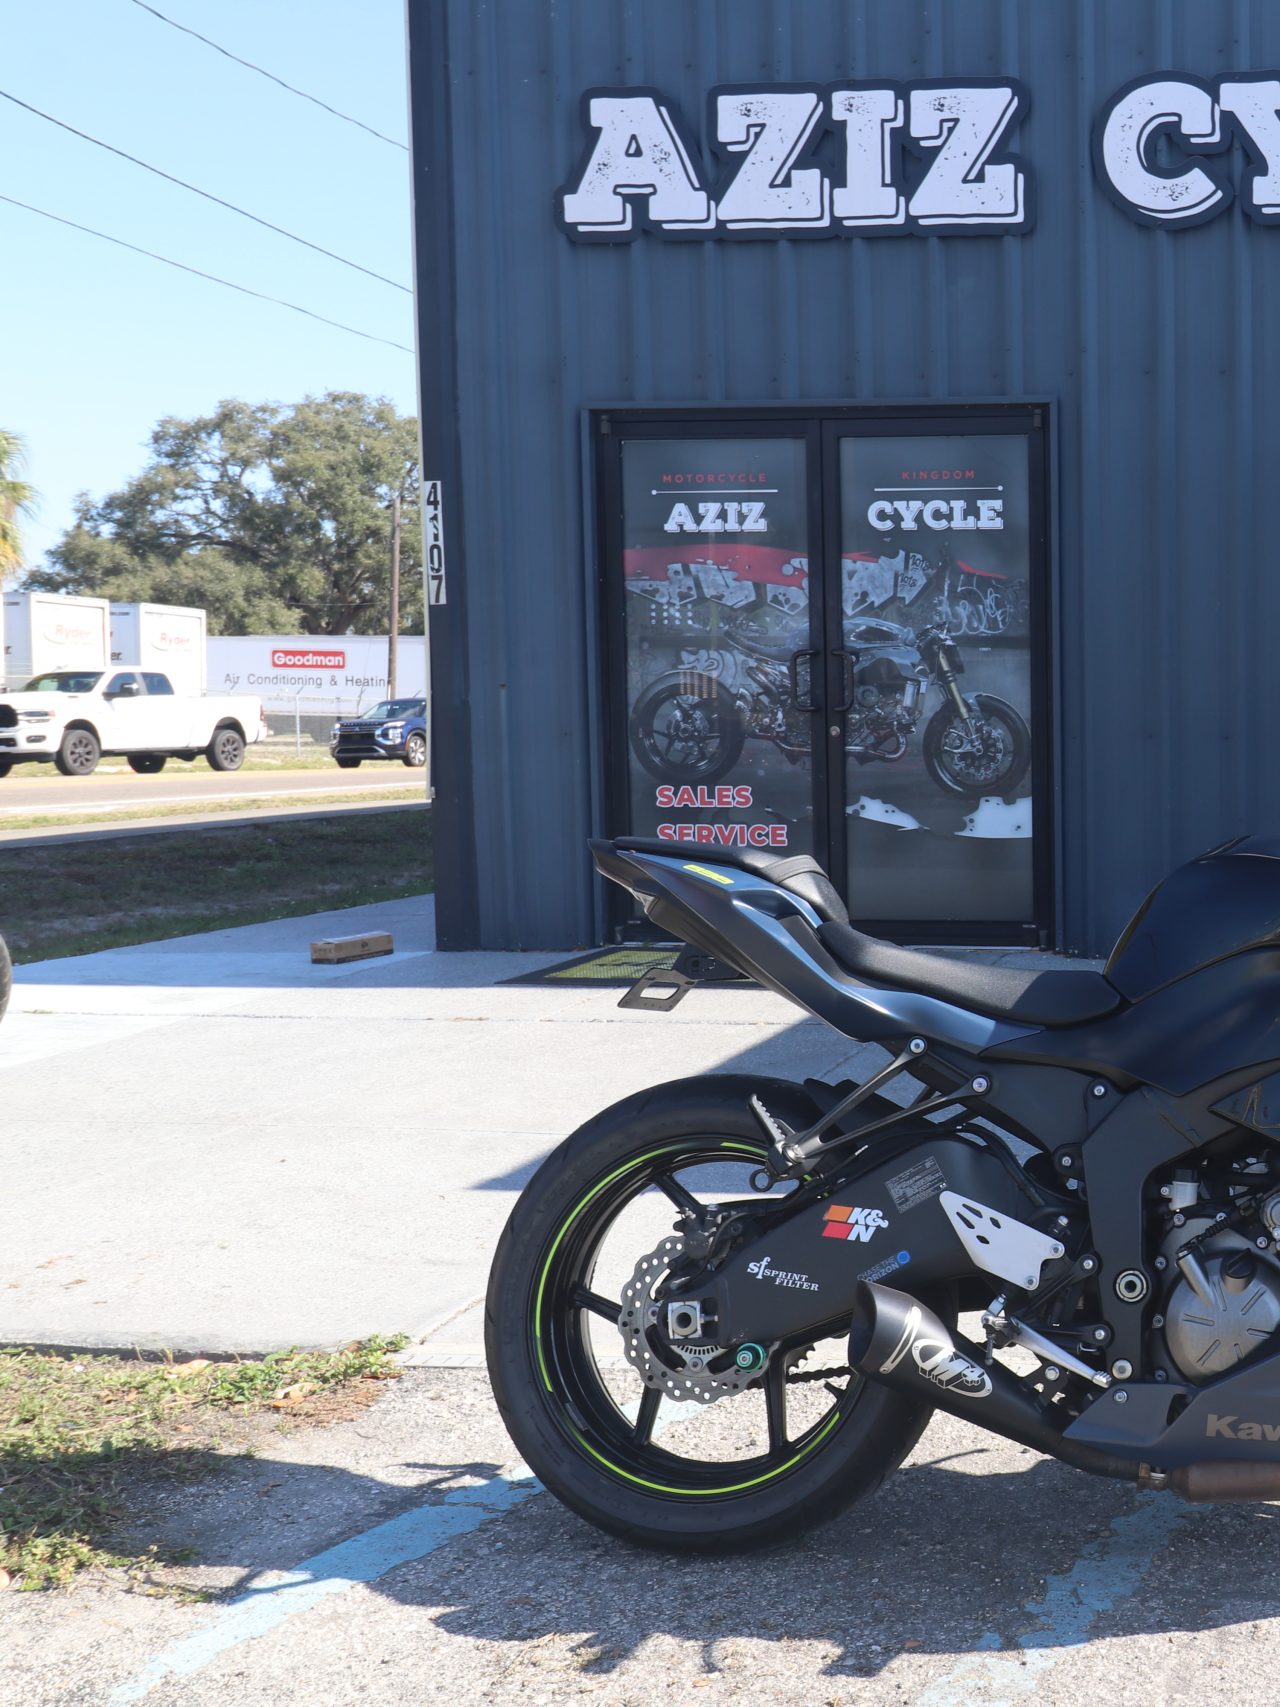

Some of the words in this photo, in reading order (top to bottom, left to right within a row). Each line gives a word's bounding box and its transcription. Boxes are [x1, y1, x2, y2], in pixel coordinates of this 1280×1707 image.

[563, 87, 1024, 231] AZIZ
[663, 473, 767, 483] MOTORCYCLE
[901, 470, 976, 480] KINGDOM
[664, 502, 767, 533] AZIZ
[867, 499, 1004, 531] CYCLE
[427, 482, 444, 604] 4107
[55, 624, 91, 639] Ryder
[160, 633, 191, 646] Ryder
[273, 652, 344, 667] Goodman
[224, 673, 240, 685] Air
[247, 673, 323, 689] Conditioning
[329, 676, 338, 687] &
[345, 675, 389, 688] Heatin
[656, 785, 753, 808] SALES
[657, 824, 788, 846] SERVICE
[763, 1268, 808, 1282] SPRINT
[864, 1262, 900, 1283] ORIZON
[774, 1278, 819, 1291] FILTER
